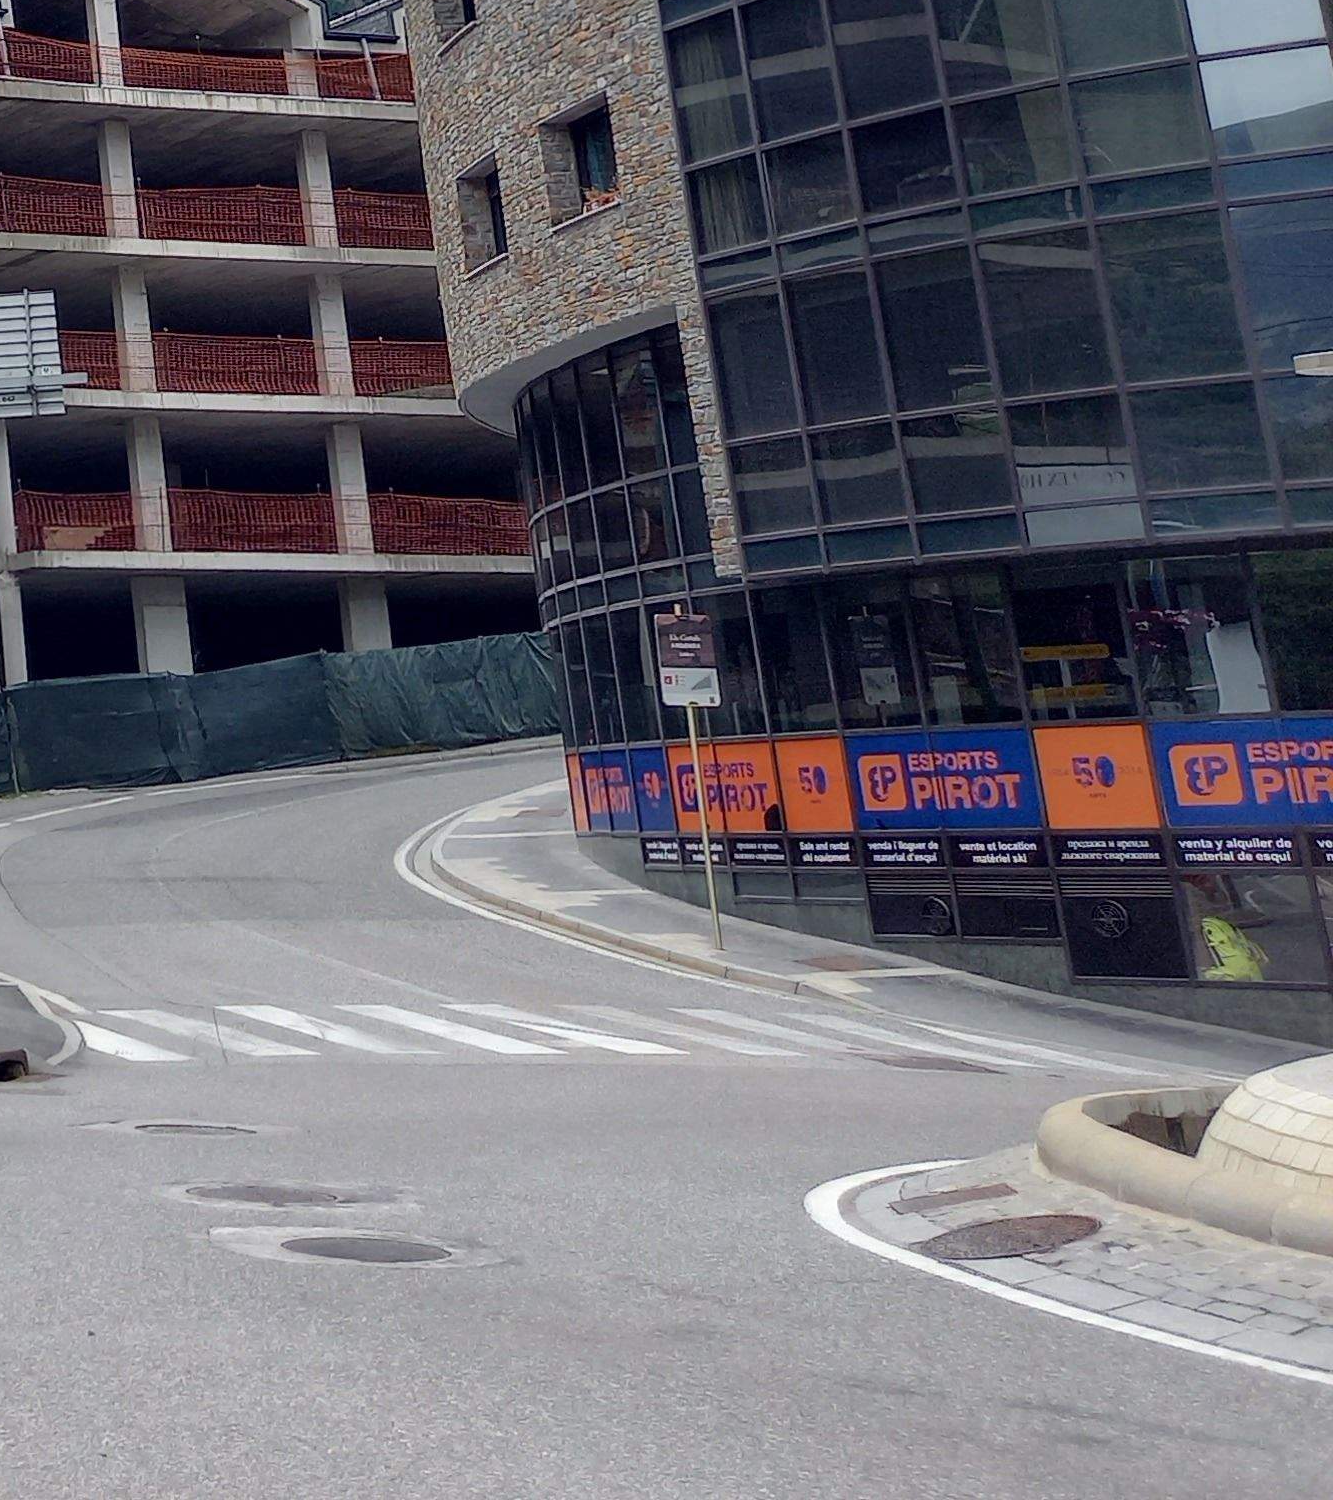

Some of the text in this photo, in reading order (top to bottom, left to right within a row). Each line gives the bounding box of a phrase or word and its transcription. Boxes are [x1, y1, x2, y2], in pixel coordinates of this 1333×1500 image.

[907, 751, 999, 772] ESPORTS
[703, 762, 755, 778] ESPORTS
[1071, 755, 1116, 788] 50
[643, 771, 662, 800] 50
[798, 765, 826, 795] 50
[706, 783, 768, 813] PIROT
[911, 774, 1021, 811] PIROT
[815, 841, 829, 850] and
[927, 840, 939, 850] de
[987, 842, 997, 851] et
[998, 840, 1037, 851] location
[1178, 837, 1293, 851] venta y alquiler de
[873, 852, 906, 862] material
[1012, 853, 1028, 864] ski
[1185, 850, 1234, 862] material
[1236, 851, 1252, 862] de
